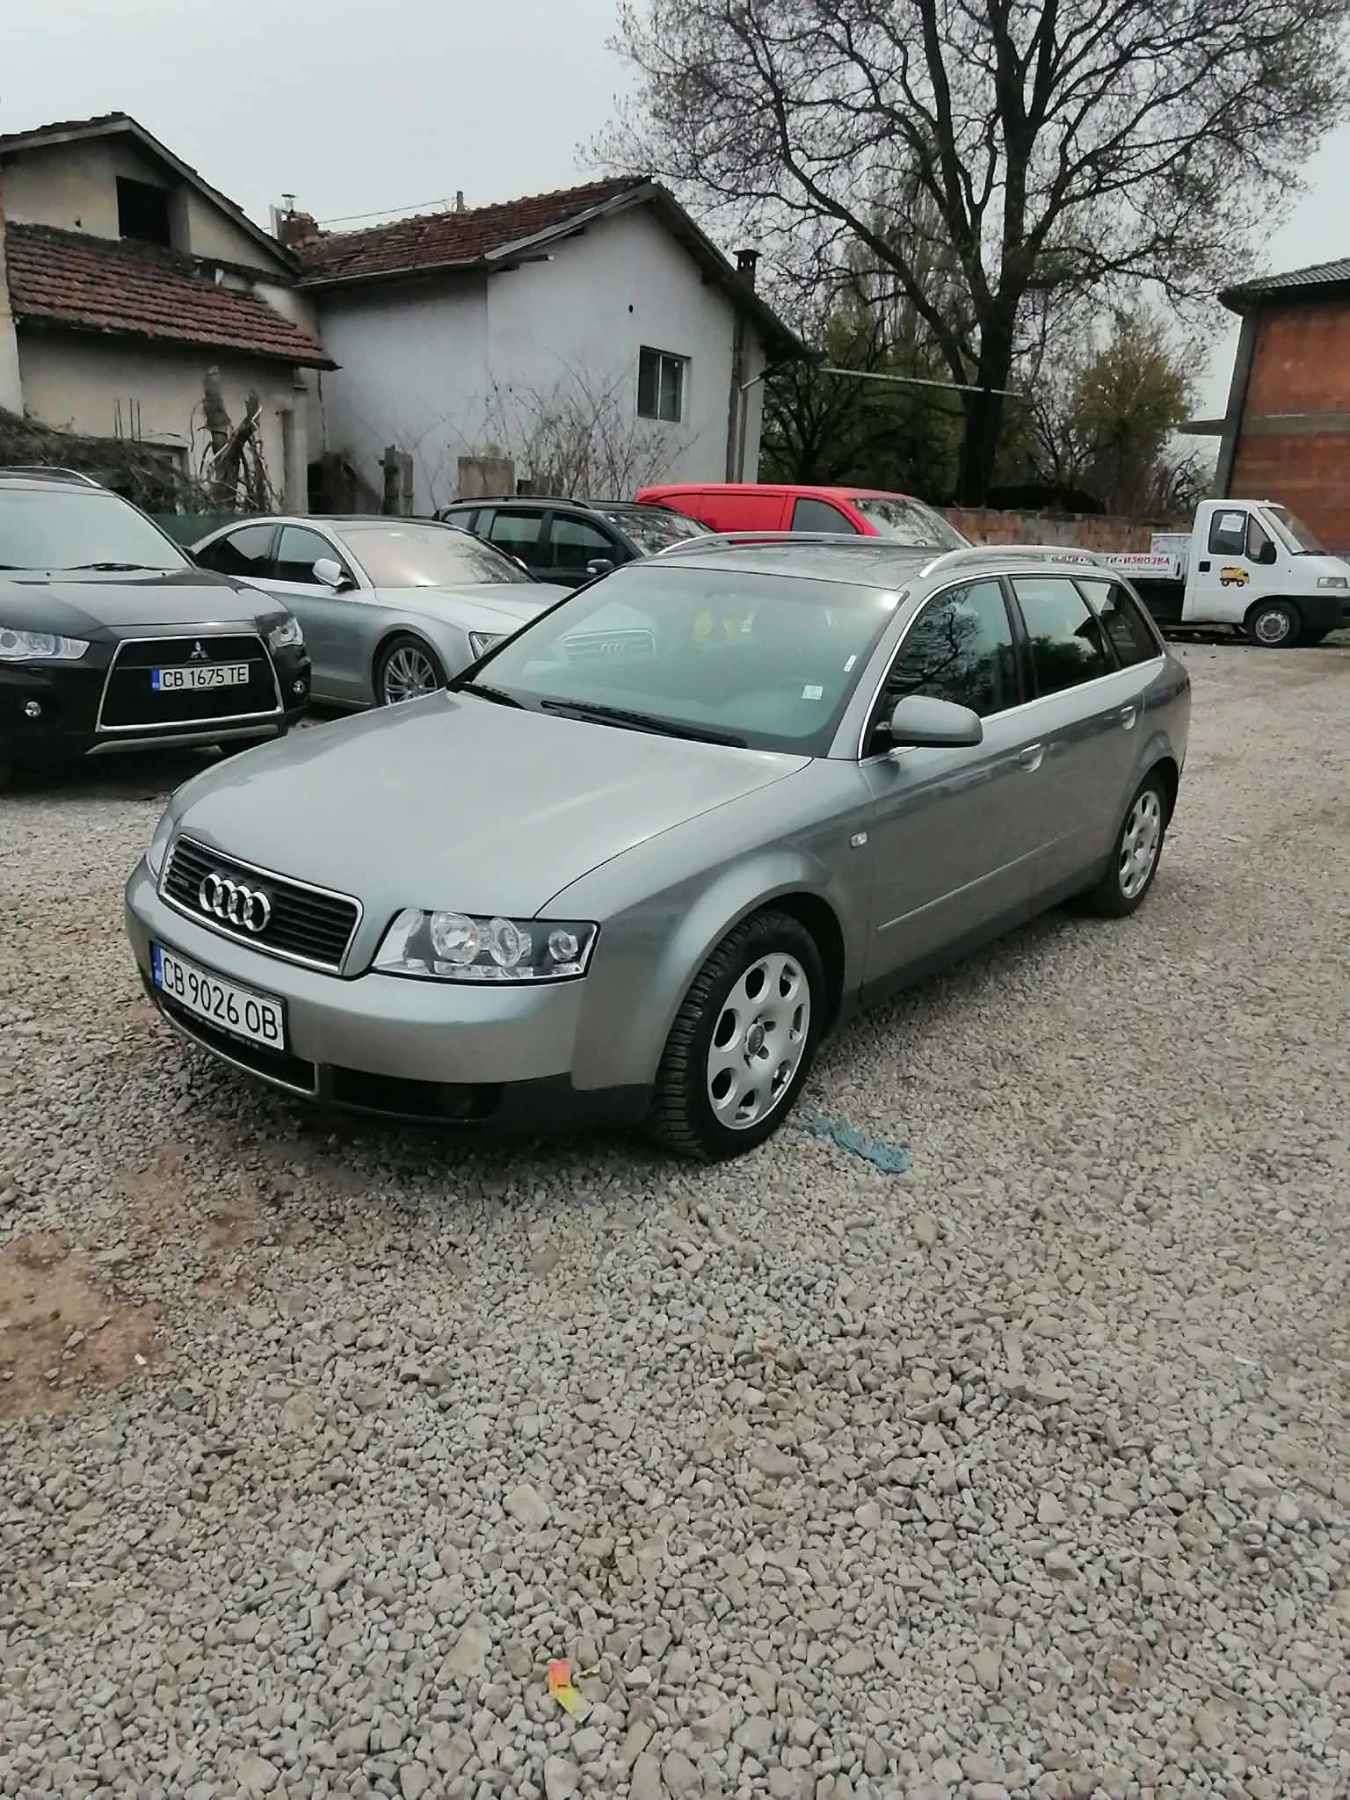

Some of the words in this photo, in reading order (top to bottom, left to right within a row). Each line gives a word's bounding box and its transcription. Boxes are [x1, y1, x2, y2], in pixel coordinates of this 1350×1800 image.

[162, 671, 184, 688] CB
[189, 668, 225, 686] 1675
[228, 666, 247, 683] TE
[163, 957, 185, 996] CB
[188, 973, 240, 1025] 9026
[245, 1000, 278, 1041] OB
